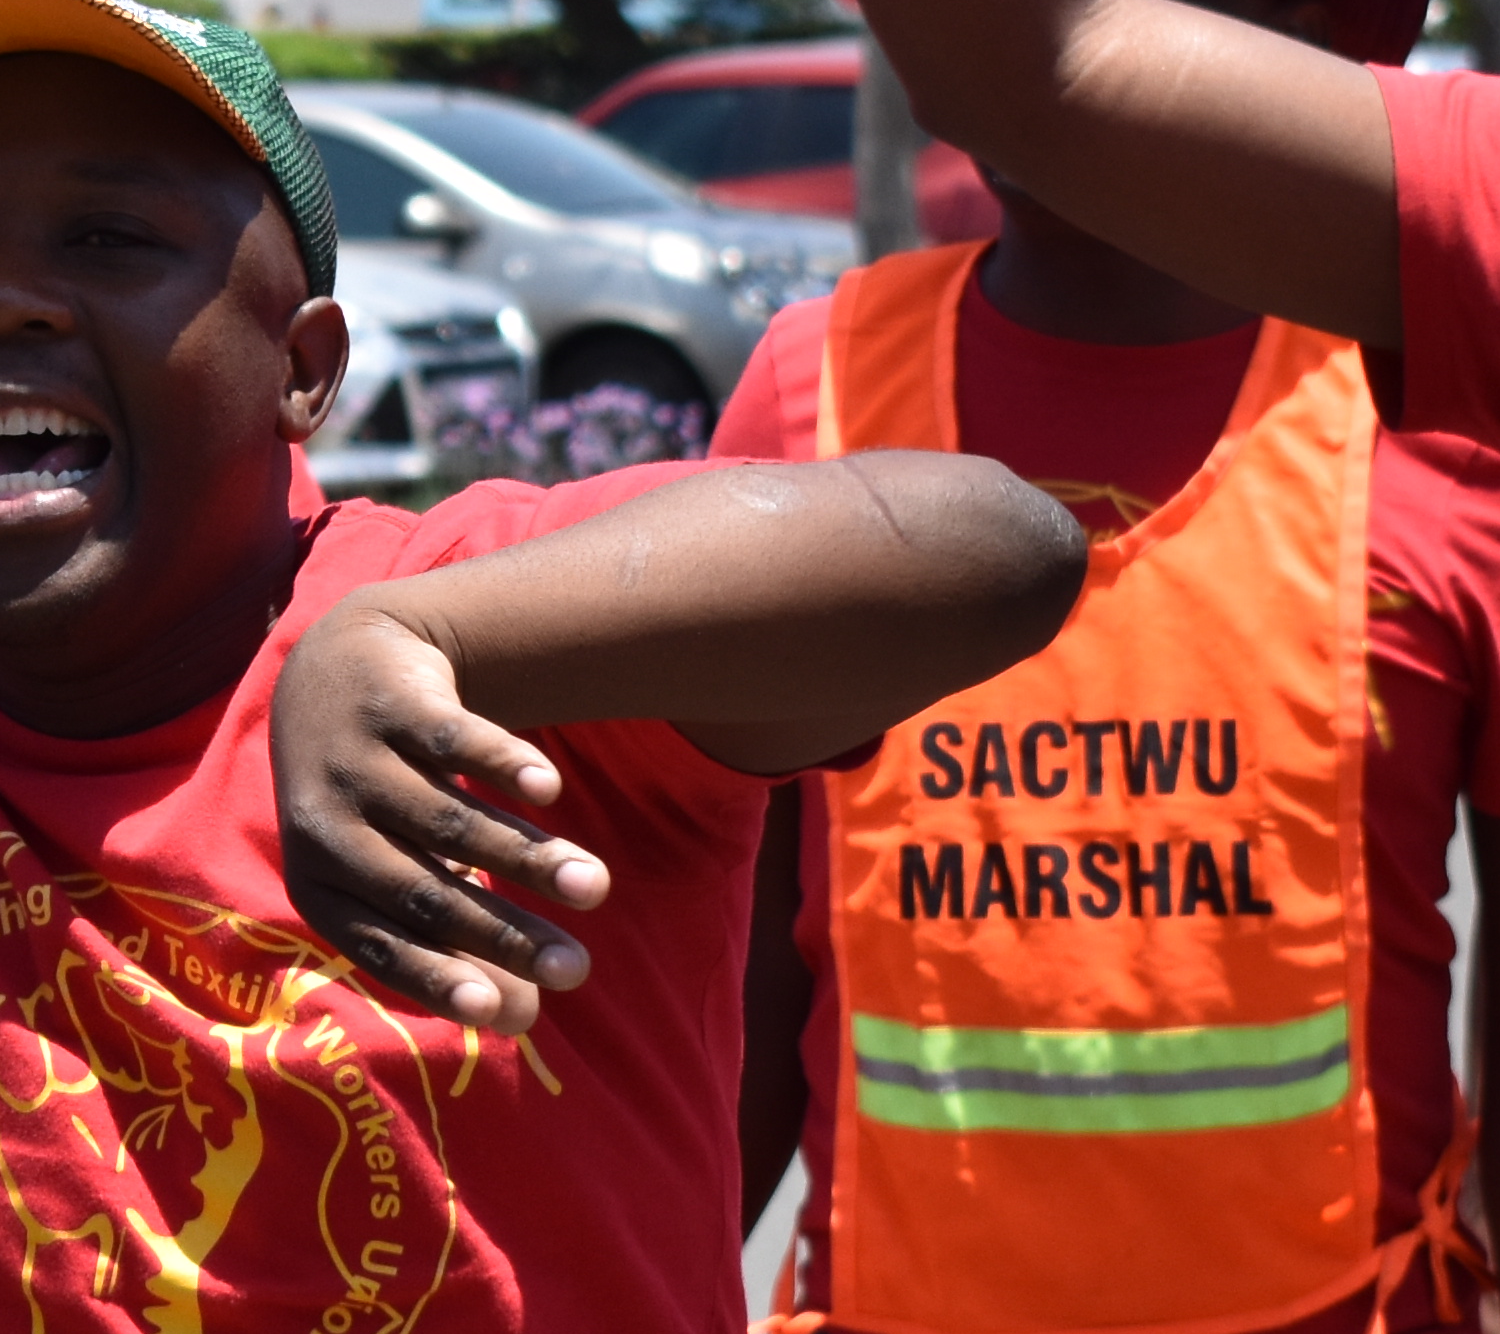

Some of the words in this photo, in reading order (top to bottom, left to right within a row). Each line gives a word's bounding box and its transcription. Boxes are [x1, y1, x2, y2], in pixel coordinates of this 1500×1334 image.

[918, 718, 1239, 800] SACTWU
[899, 840, 1274, 920] MARSHAL
[303, 1013, 401, 1219] Workers
